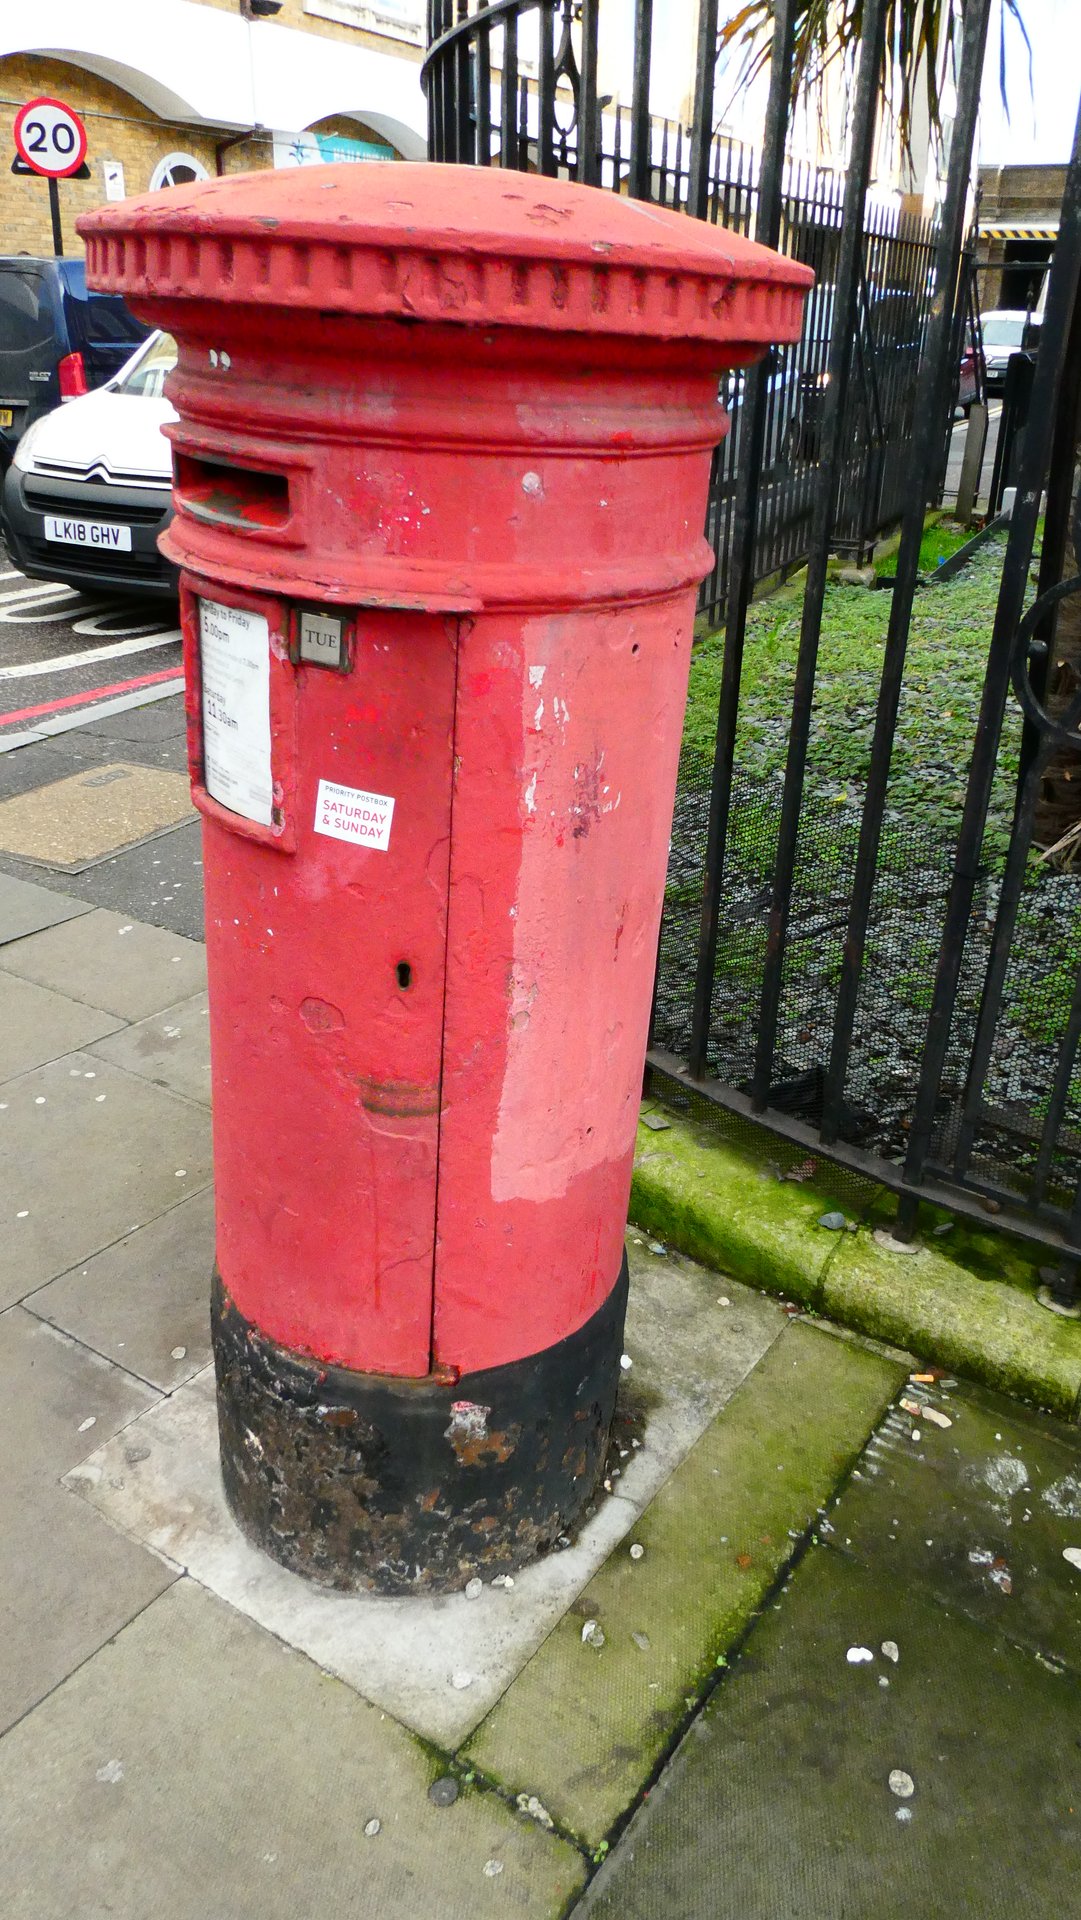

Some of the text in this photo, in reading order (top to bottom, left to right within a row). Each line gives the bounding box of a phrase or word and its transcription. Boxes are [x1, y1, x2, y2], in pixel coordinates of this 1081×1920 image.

[26, 122, 75, 154] 20
[54, 520, 120, 546] LK18 GHV
[305, 629, 337, 649] TUE
[324, 785, 388, 806] PRIORITY POSTBOX
[322, 799, 387, 825] SATURDAY
[322, 814, 384, 839] & SUNDAY
